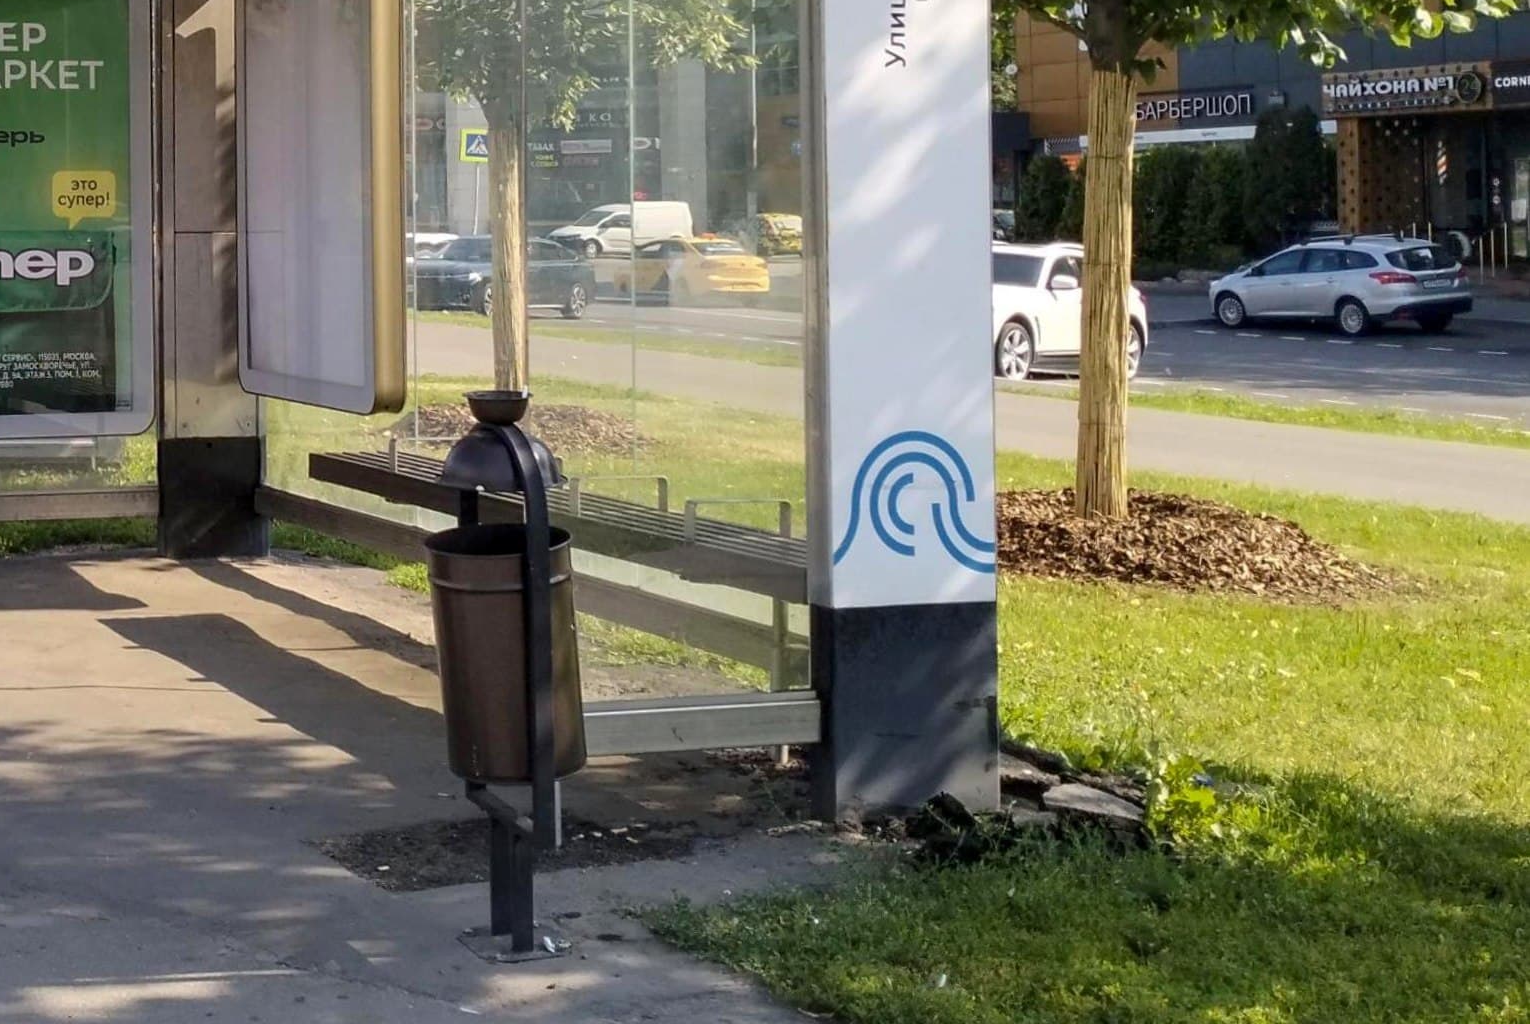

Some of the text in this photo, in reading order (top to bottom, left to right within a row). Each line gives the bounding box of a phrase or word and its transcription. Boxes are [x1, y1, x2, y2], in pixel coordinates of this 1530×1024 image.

[1322, 78, 1420, 99] ЧАЙХОНА
[1135, 94, 1251, 121] БАРБЕРШОП
[71, 180, 98, 191] это
[58, 192, 110, 208] супер!
